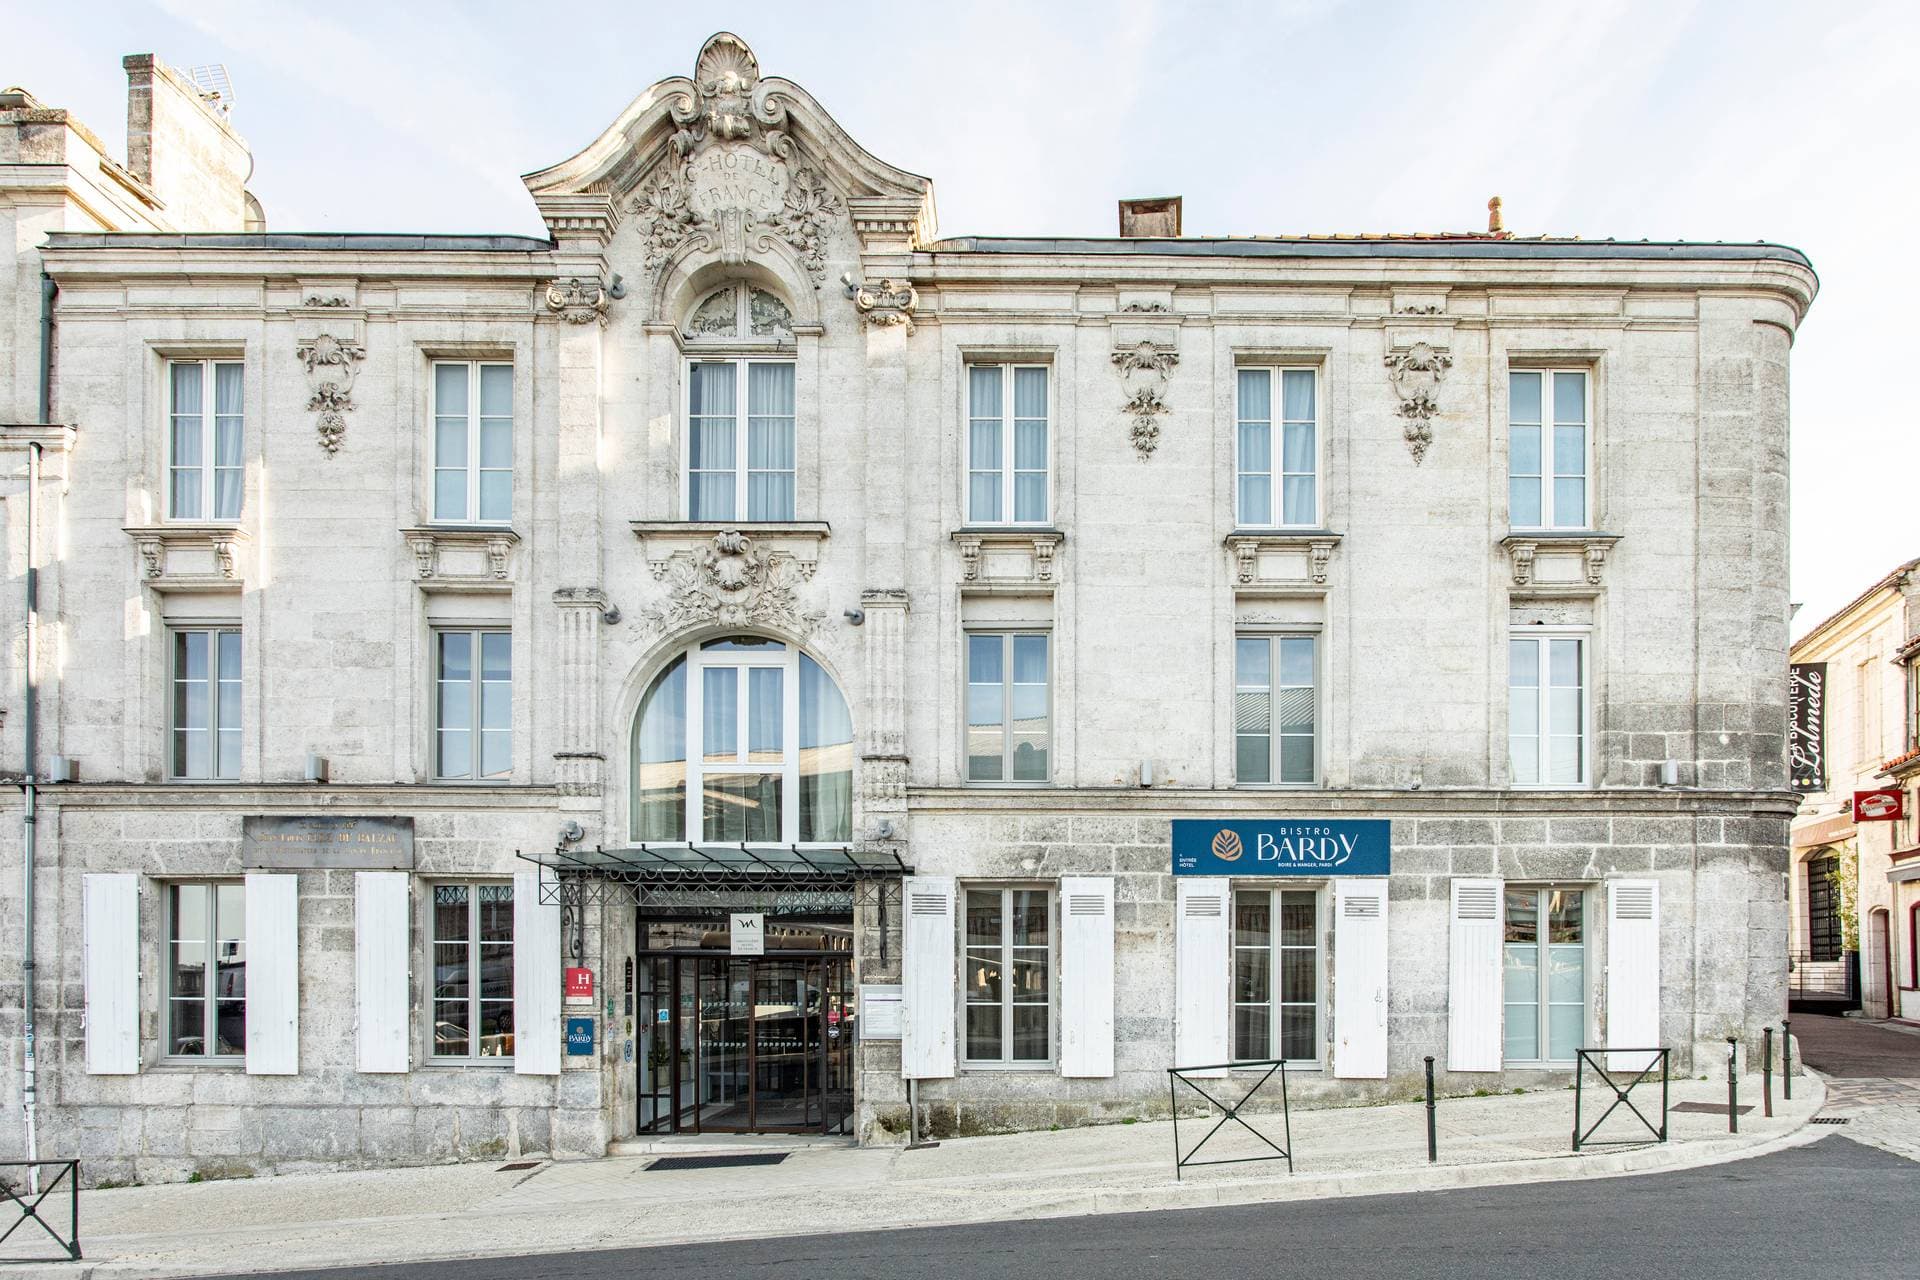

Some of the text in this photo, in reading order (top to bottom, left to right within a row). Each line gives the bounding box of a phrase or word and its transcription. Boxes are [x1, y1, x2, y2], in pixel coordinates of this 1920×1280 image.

[724, 172, 737, 180] DE
[698, 184, 770, 209] FRANCE
[1281, 827, 1330, 835] BISTRO
[357, 833, 397, 843] BALZAC
[1258, 833, 1358, 866] BARDY
[578, 973, 590, 985] H
[568, 1034, 592, 1042] BARDY
